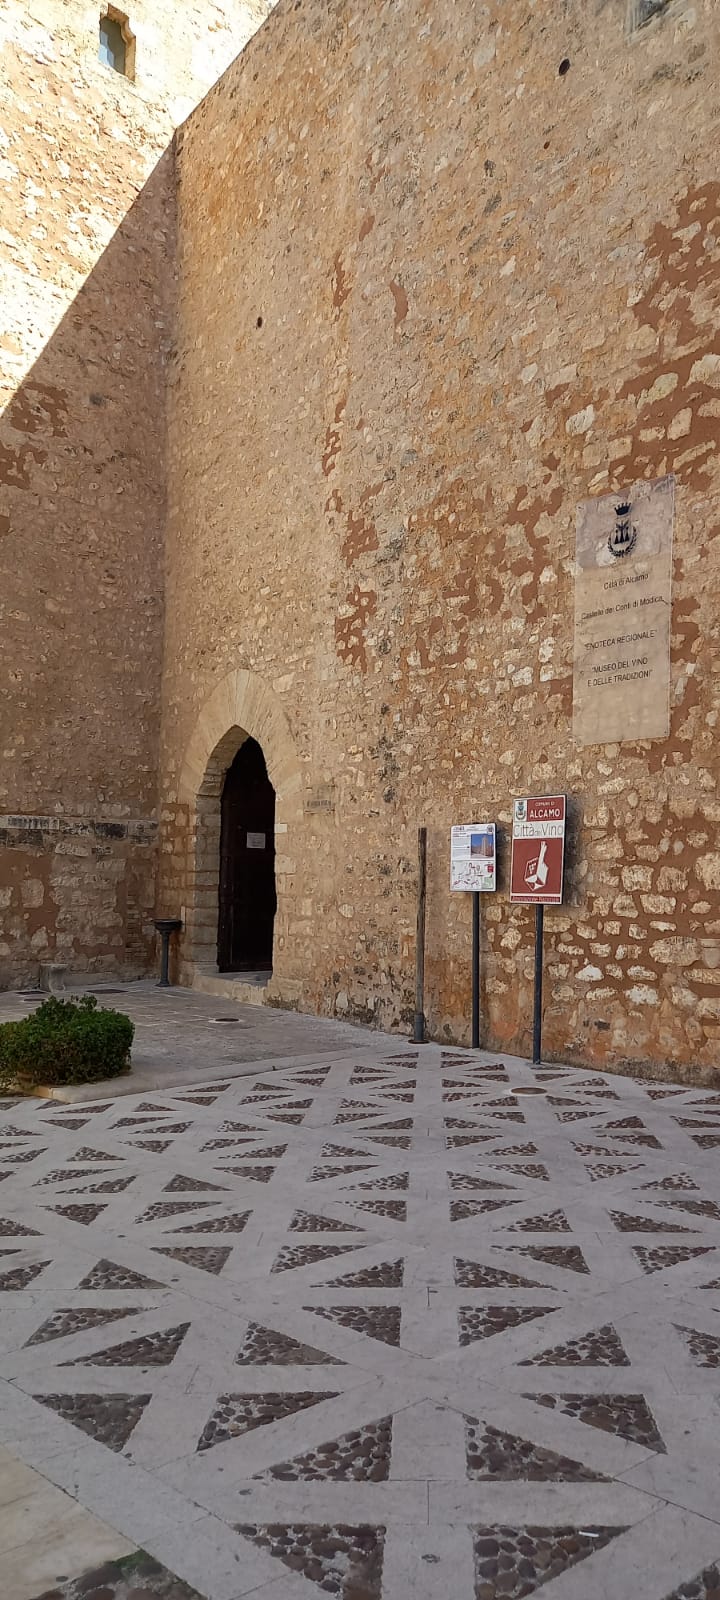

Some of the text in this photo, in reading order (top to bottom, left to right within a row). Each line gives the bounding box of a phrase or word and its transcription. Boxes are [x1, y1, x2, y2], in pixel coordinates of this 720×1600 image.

[625, 573, 649, 585] Alcamo
[581, 608, 604, 620] Castello
[632, 600, 639, 608] di
[640, 596, 663, 606] Modica
[617, 660, 630, 669] DEL
[631, 657, 648, 667] VINO
[587, 679, 592, 687] E
[592, 676, 613, 687] DELLE
[530, 808, 561, 818] ALCAMO
[514, 823, 535, 837] Città
[541, 823, 564, 836] Vino
